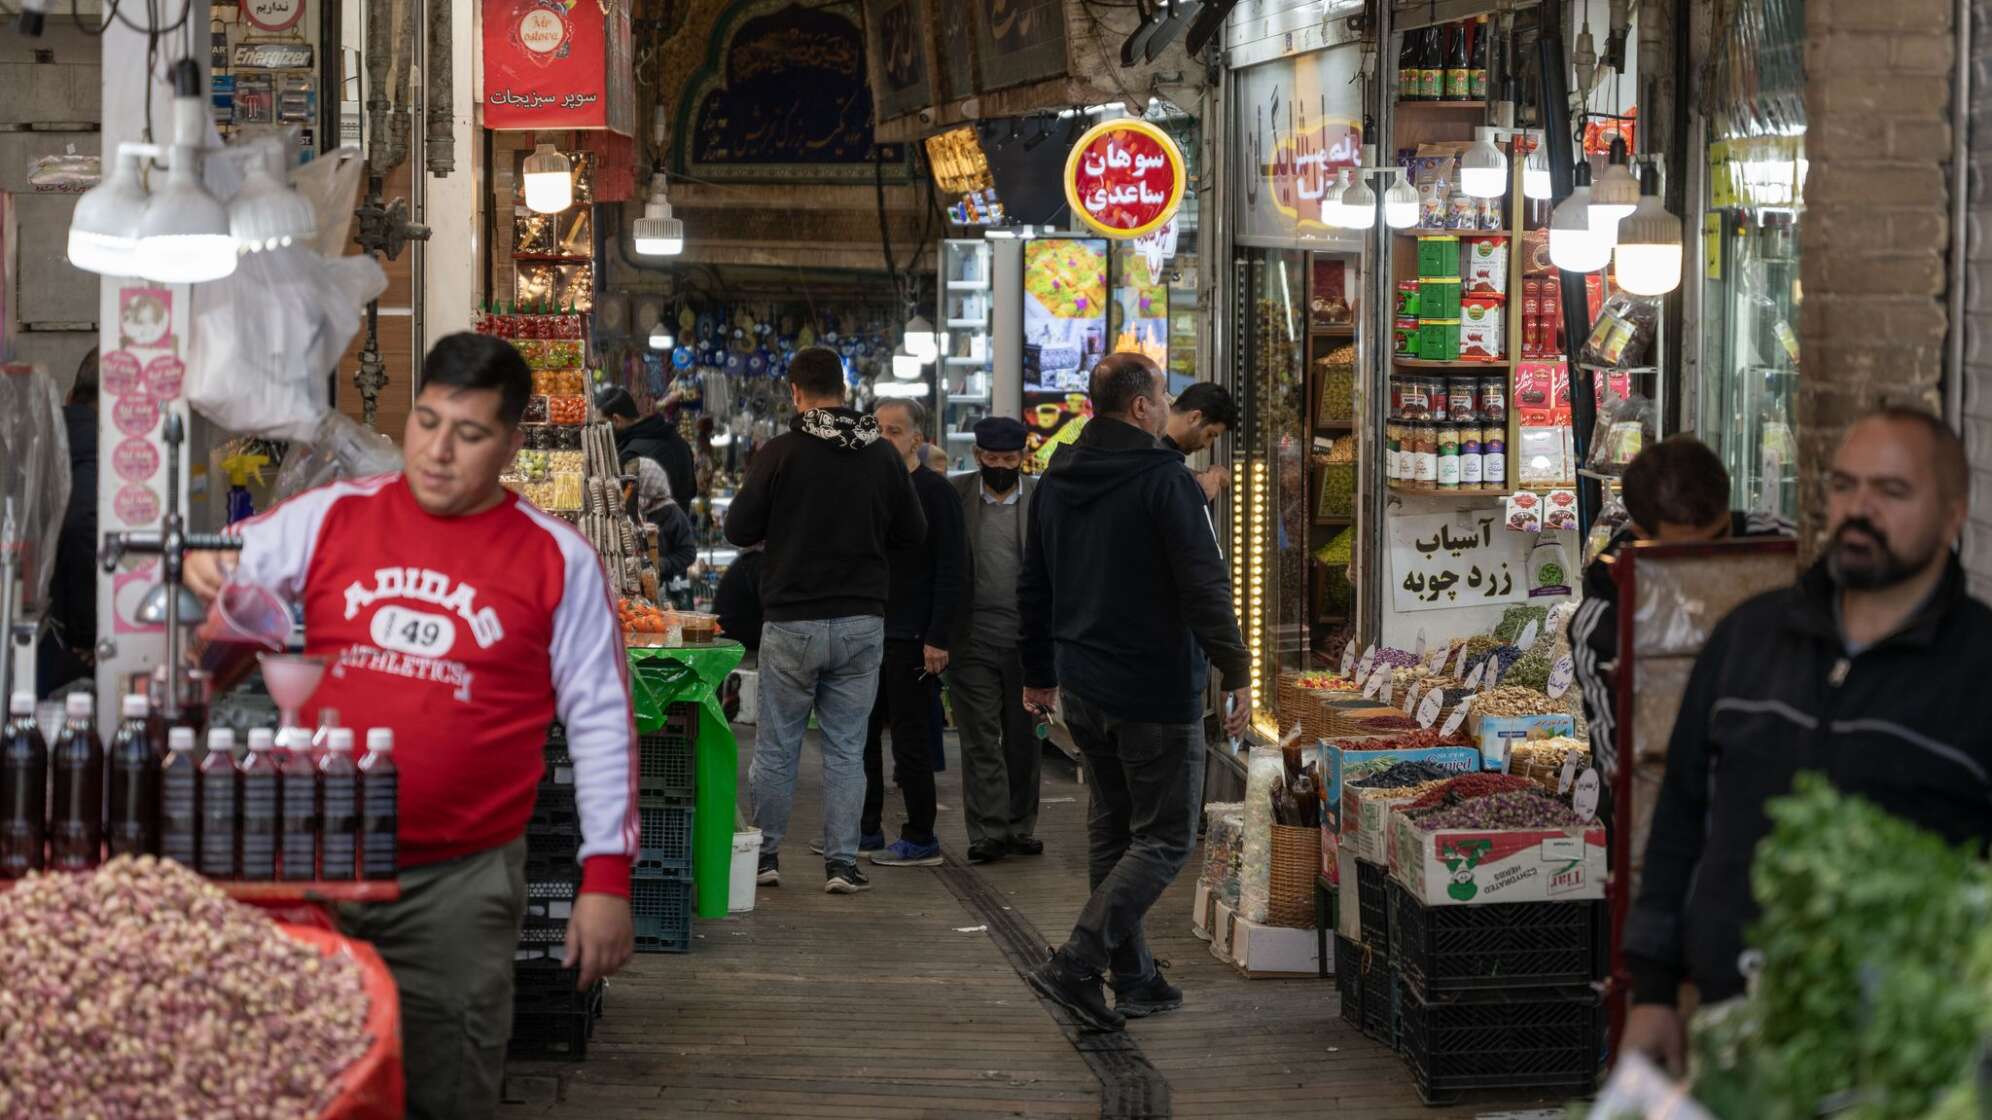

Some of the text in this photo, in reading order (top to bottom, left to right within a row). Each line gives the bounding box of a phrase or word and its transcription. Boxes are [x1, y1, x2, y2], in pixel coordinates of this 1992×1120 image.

[234, 47, 311, 67] Energizer
[490, 89, 598, 108] سوپر سبزیجات
[1084, 143, 1164, 176] سوهان
[1085, 180, 1164, 211] ساعدی
[1416, 518, 1495, 560] آسیاب
[1403, 562, 1512, 601] زرد چوبه
[343, 566, 505, 649] ADIDAS
[401, 619, 440, 647] 49
[332, 643, 475, 702] ATHLETICS
[1550, 870, 1584, 888] Tiar
